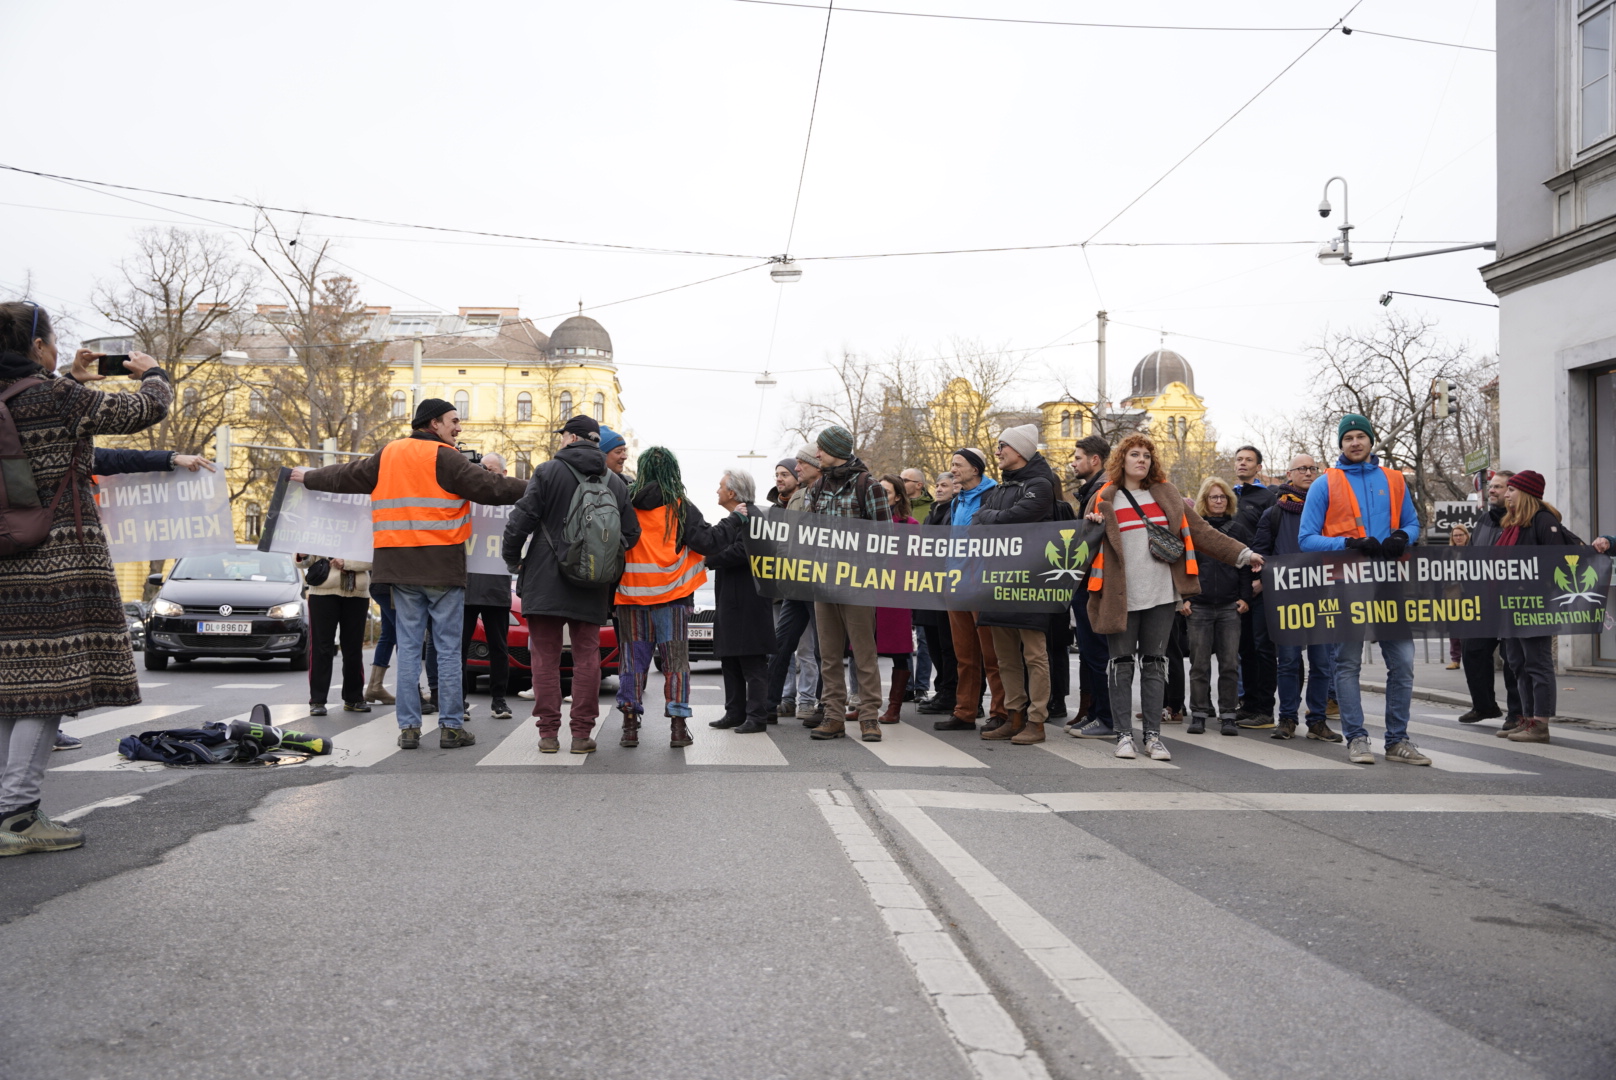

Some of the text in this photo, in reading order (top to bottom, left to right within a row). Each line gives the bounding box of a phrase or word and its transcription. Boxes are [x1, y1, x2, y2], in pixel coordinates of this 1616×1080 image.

[750, 516, 1022, 557] UND WENN DIE REGIERUNG
[750, 555, 962, 593] KEINEN PLAN HAT?
[982, 570, 1029, 584] LETZTE
[1273, 557, 1539, 590] KEINE NEUEN BOHRUNGEN!
[994, 586, 1073, 602] GENERATION
[1500, 595, 1545, 609] LETZTE
[1277, 603, 1315, 630] 100
[1351, 600, 1398, 624] SIND
[1404, 596, 1481, 622] GENUG!
[1513, 608, 1605, 626] GENERATION.AT
